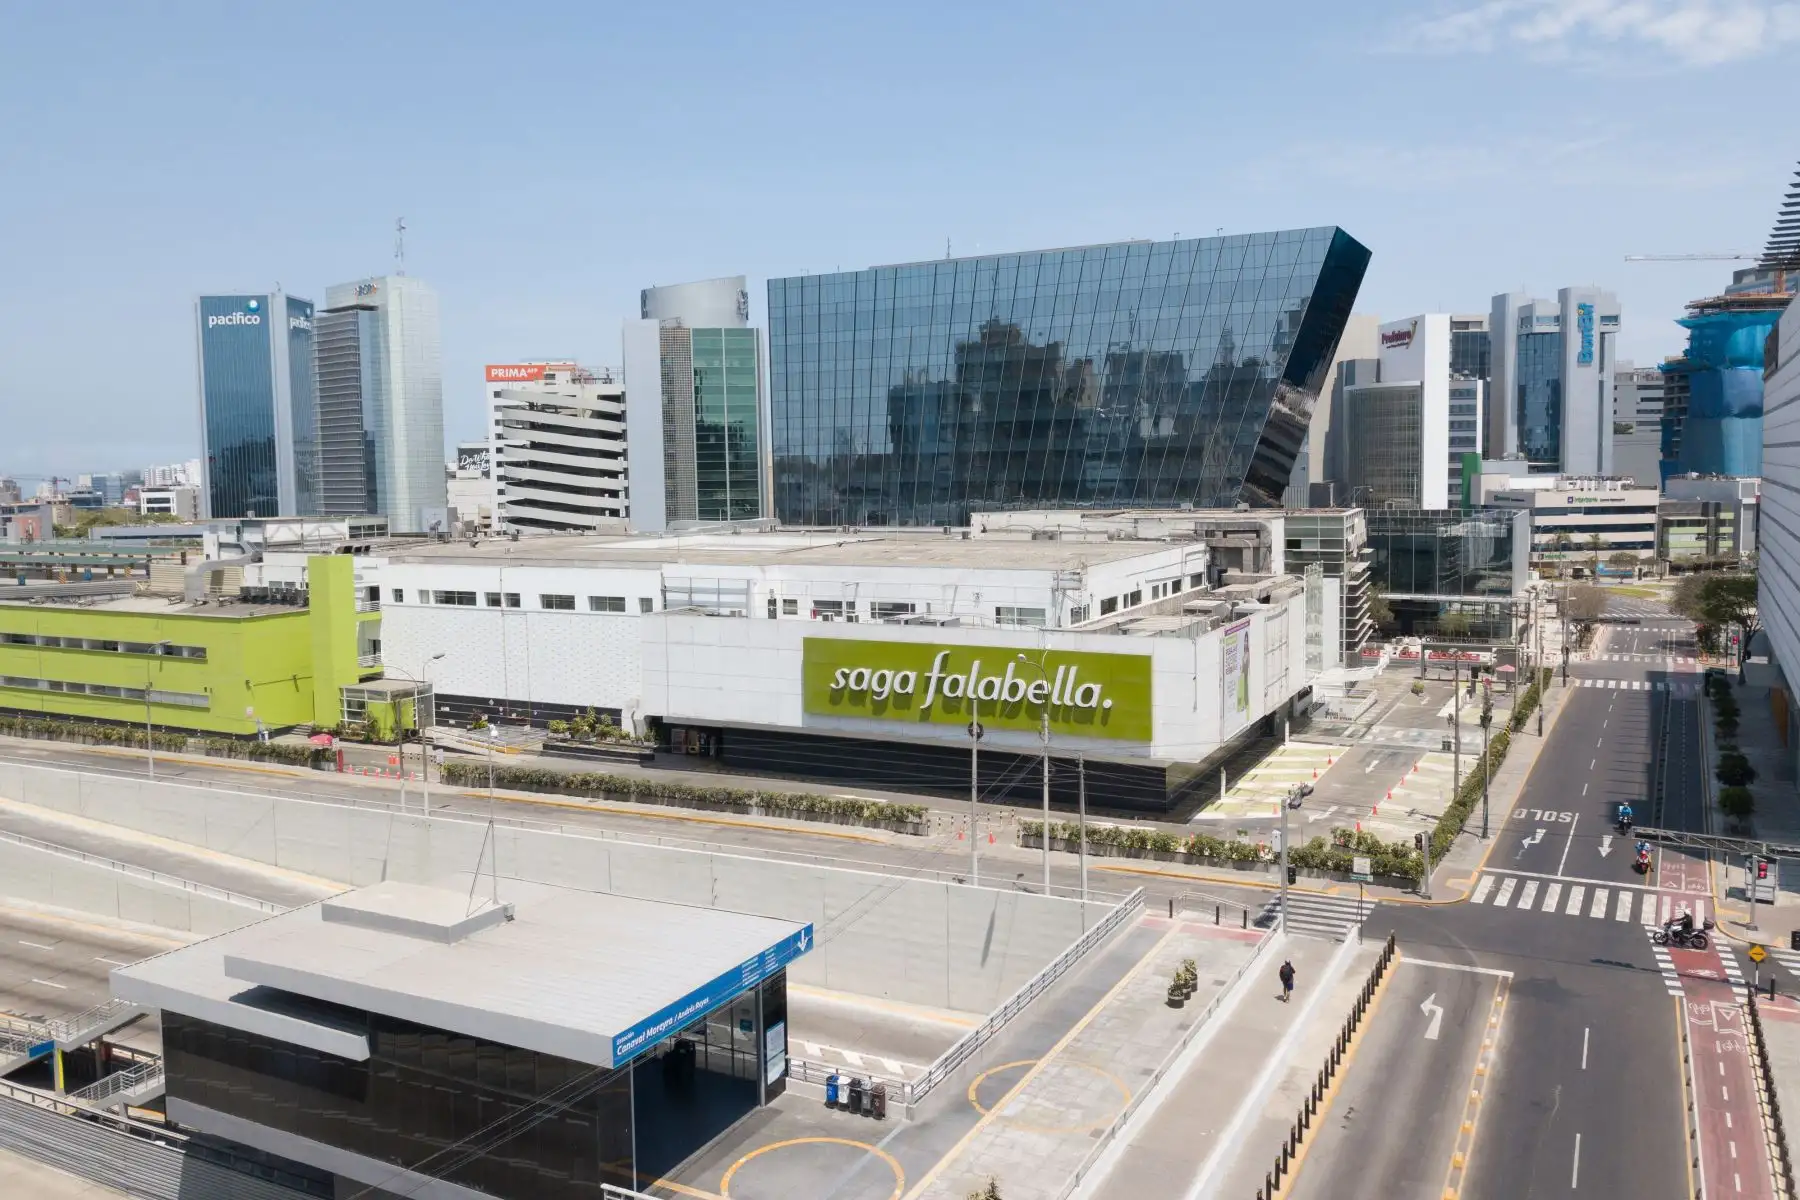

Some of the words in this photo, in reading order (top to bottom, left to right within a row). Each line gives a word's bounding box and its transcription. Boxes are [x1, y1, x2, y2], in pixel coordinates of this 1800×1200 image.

[491, 368, 528, 378] PRIMA
[830, 667, 917, 699] saga
[1511, 808, 1574, 823] SOLO
[617, 1032, 645, 1056] Canaval
[645, 1017, 673, 1038] Moreyra
